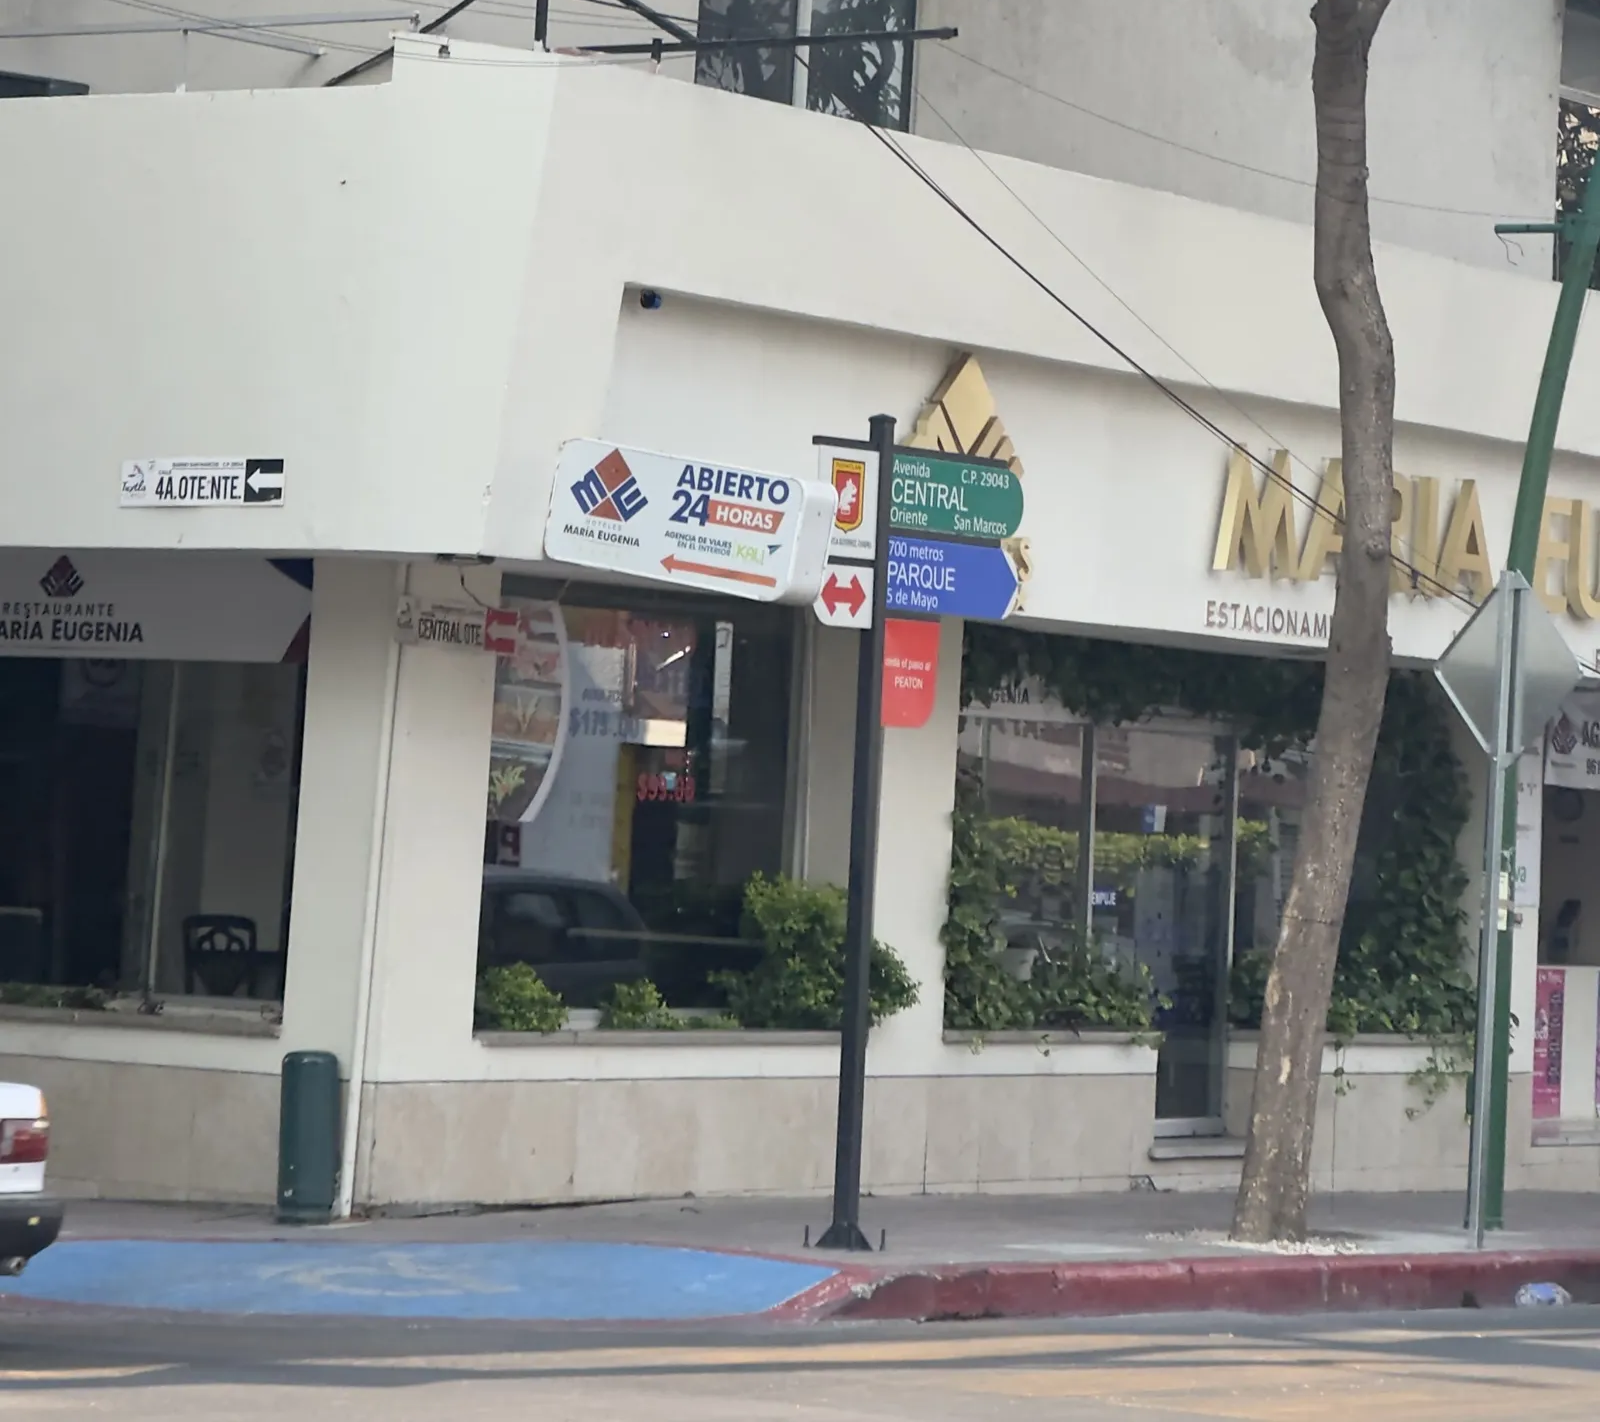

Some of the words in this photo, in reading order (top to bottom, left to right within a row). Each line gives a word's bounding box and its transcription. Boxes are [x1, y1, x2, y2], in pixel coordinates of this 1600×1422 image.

[892, 459, 930, 479] Avenida
[676, 464, 790, 505] ABIERTO
[980, 472, 1010, 489] 29043
[891, 478, 969, 512] CENTRAL
[668, 489, 711, 527] 24
[715, 504, 774, 530] HORAS
[890, 506, 928, 527] Oriente
[954, 514, 971, 531] San
[973, 517, 1008, 535] Marcos
[597, 530, 640, 547] EUGENIA
[664, 530, 696, 543] AGENCIA
[698, 536, 707, 545] DE
[709, 538, 733, 549] VIAJES
[677, 540, 687, 549] EN
[689, 543, 696, 551] EL
[698, 544, 731, 557] INTERIOR
[888, 539, 908, 558] 700
[909, 546, 944, 562] metros
[887, 560, 956, 593] PARQUE
[2, 602, 115, 618] RESTAURANTE
[886, 587, 893, 604] 5
[895, 588, 908, 605] de
[910, 590, 938, 612] Mayo
[51, 619, 143, 642] EUGENIA
[418, 616, 462, 644] CENTRAL
